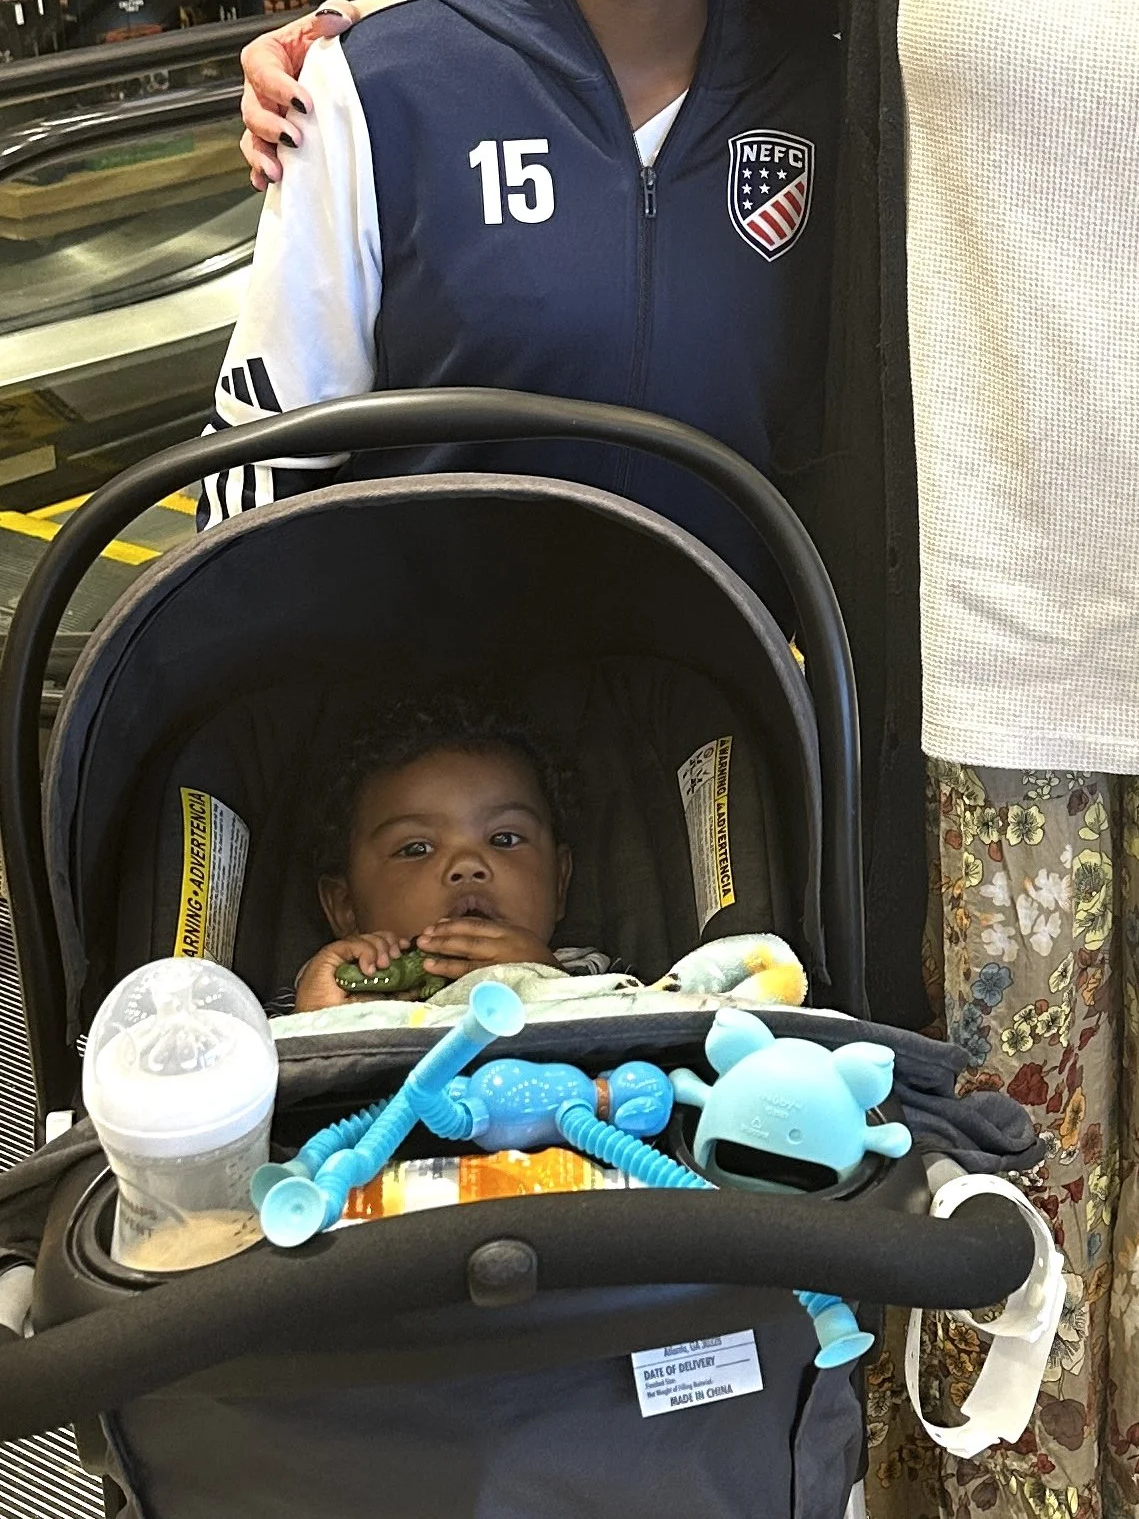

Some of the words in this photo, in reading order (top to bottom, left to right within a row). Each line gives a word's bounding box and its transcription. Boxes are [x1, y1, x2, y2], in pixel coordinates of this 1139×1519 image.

[468, 138, 556, 225] 15
[742, 143, 804, 169] NEFC
[188, 792, 206, 893] ADVERTENCIA
[716, 810, 733, 899] ADVERTENCIA
[182, 896, 203, 958] ARNING
[643, 1366, 665, 1381] DATE
[665, 1364, 676, 1376] OF
[678, 1355, 716, 1374] DELIVERY
[670, 1392, 693, 1407] MADE
[695, 1390, 705, 1401] IN
[706, 1384, 734, 1399] CHINA
